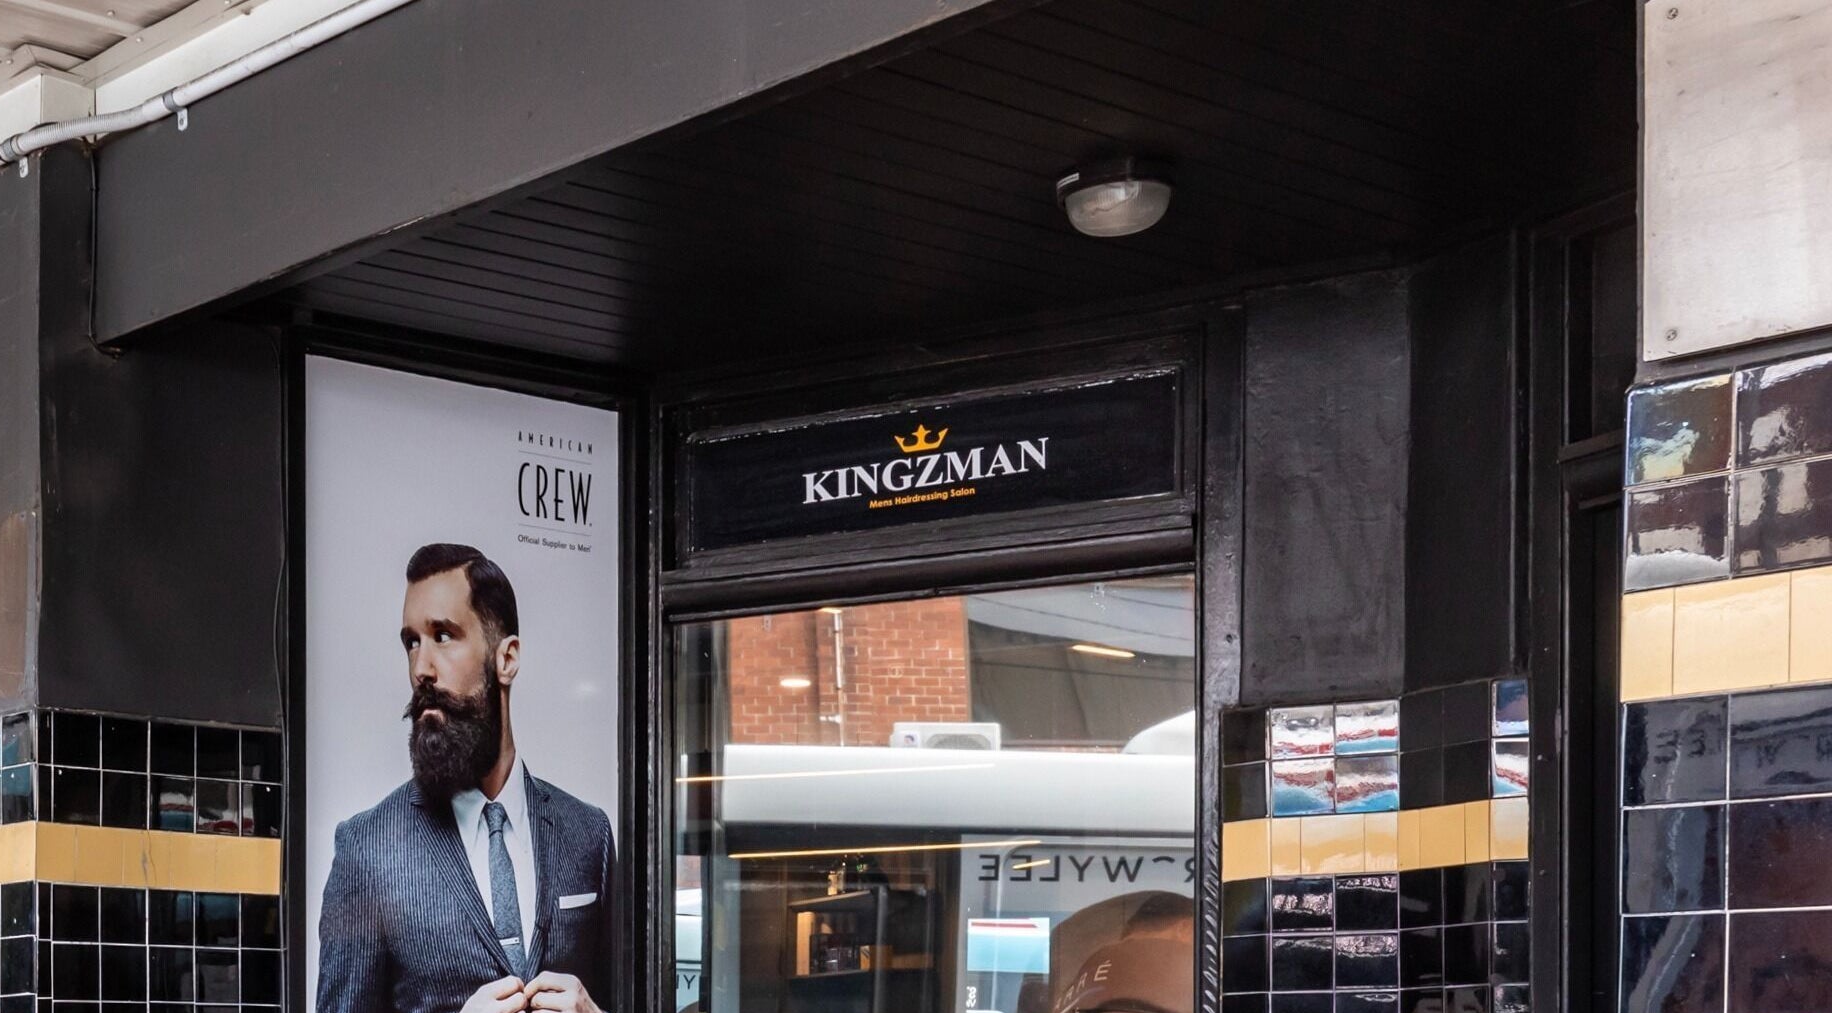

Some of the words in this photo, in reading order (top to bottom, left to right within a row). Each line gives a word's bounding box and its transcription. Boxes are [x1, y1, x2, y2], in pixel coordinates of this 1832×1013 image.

[518, 430, 593, 455] AMERICAN
[802, 437, 1049, 504] KINGZMAN
[869, 497, 893, 509] Mens
[895, 491, 948, 506] Hairdressing
[950, 486, 976, 498] Salon
[518, 534, 540, 545] Official
[542, 538, 567, 550] Supplier
[569, 543, 576, 551] to
